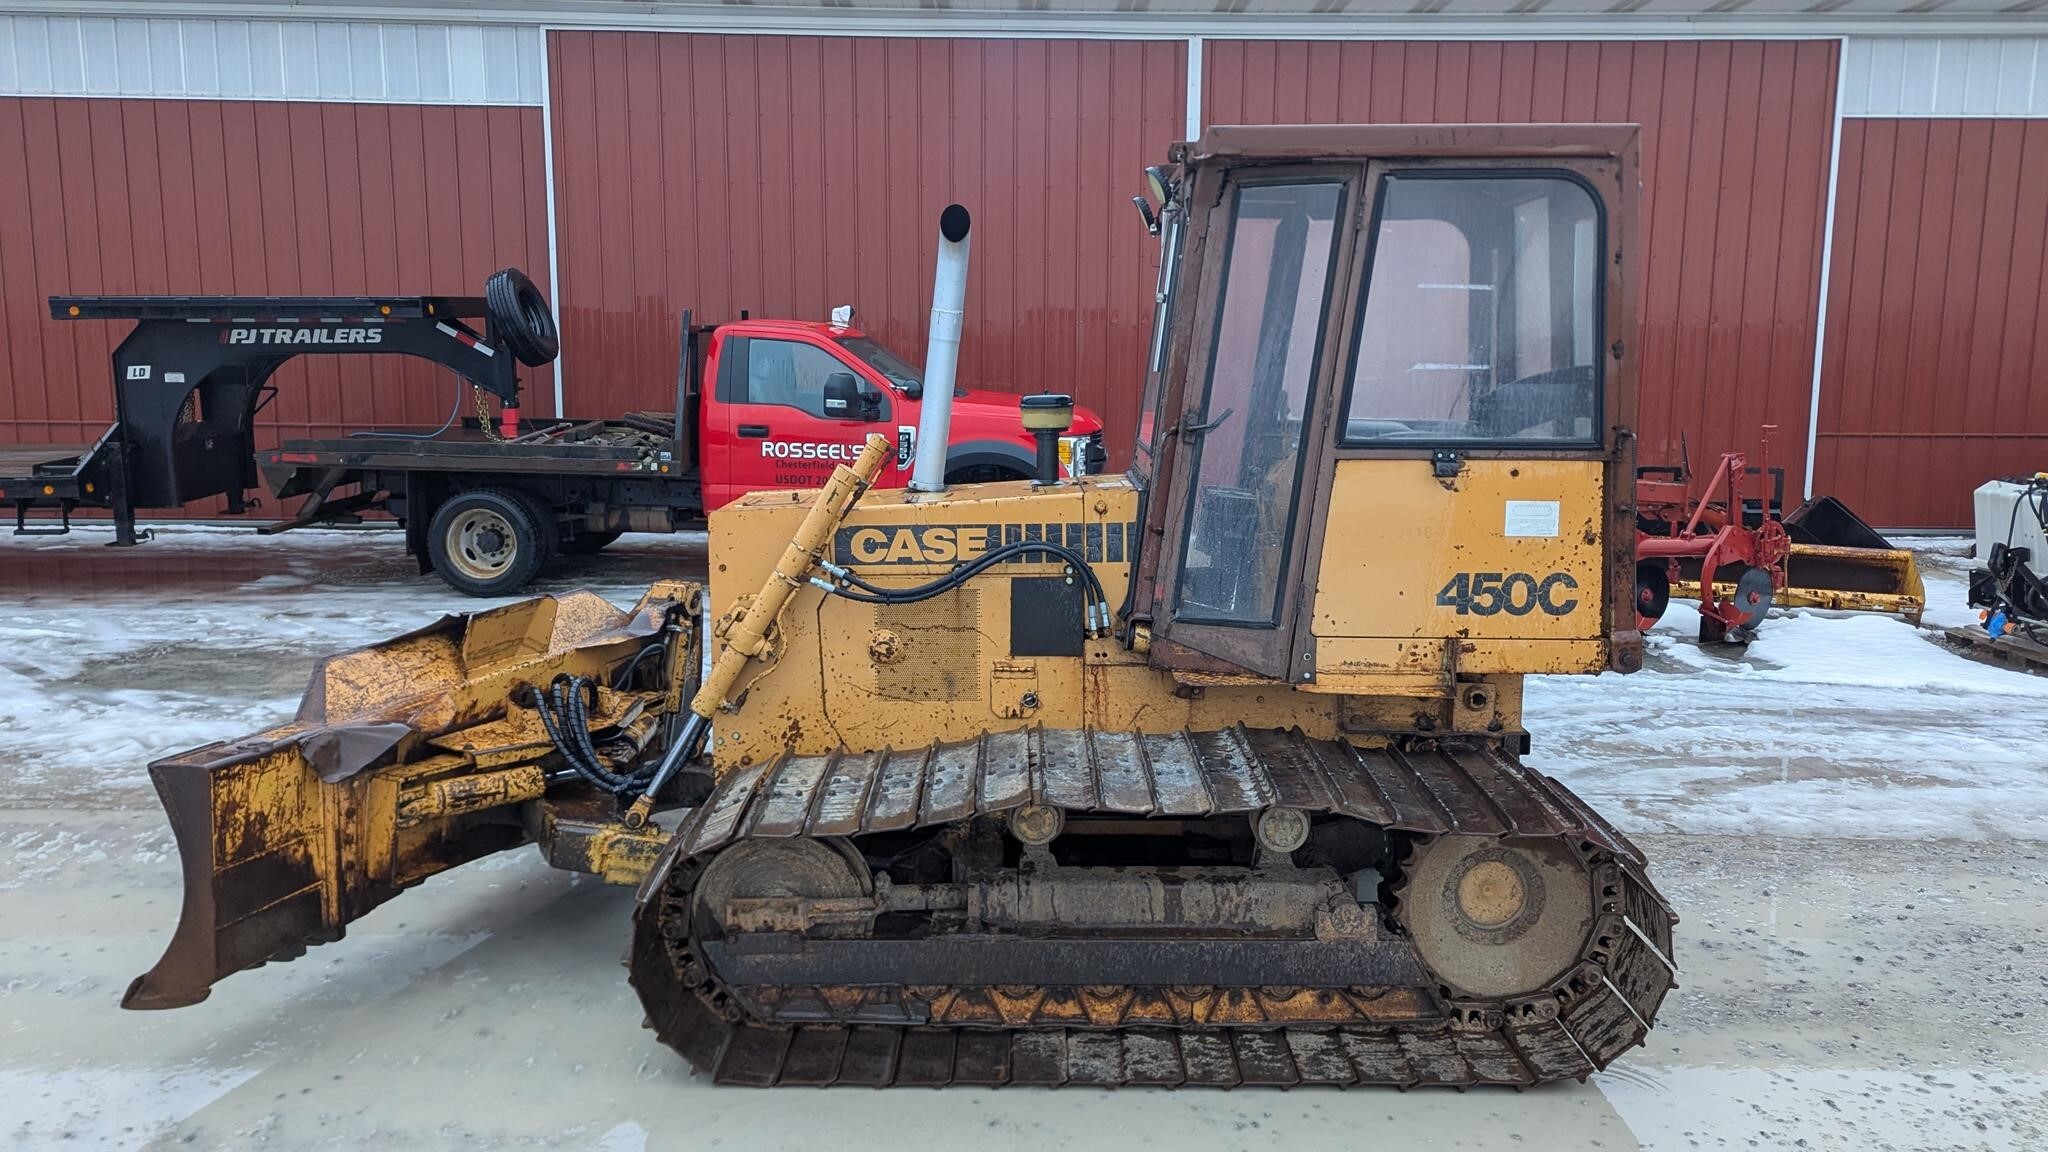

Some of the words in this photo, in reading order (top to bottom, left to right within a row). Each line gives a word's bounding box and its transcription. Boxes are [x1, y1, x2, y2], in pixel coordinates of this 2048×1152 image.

[229, 328, 255, 344] PJ
[258, 328, 382, 344] TRAILERS
[133, 367, 146, 378] LD
[762, 441, 865, 460] ROSSEEL'S
[776, 474, 812, 485] USDOT
[850, 528, 988, 563] CASE
[1435, 572, 1579, 617] 450C
